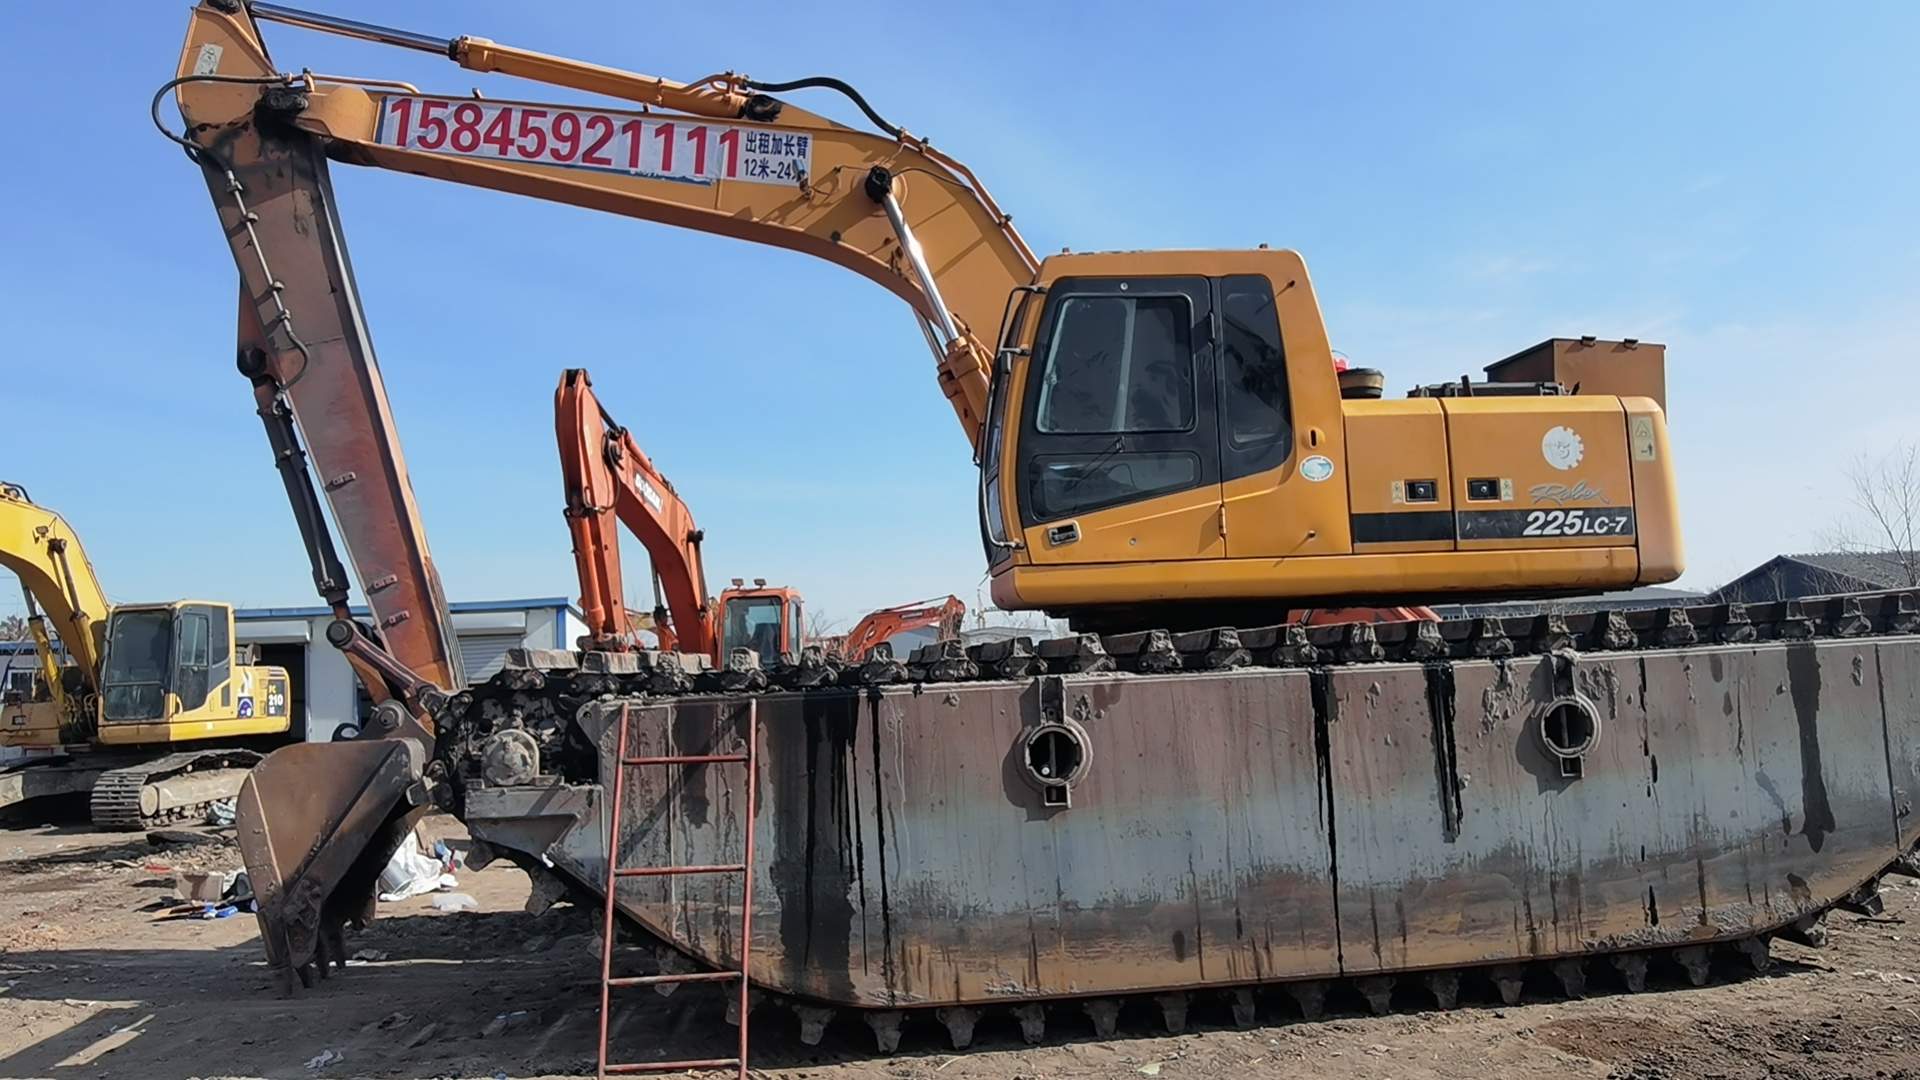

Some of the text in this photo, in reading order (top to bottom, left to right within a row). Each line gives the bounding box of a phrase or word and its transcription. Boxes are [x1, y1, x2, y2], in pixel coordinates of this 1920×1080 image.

[390, 98, 739, 178] 15845921111
[745, 131, 808, 159] 出租加长臂
